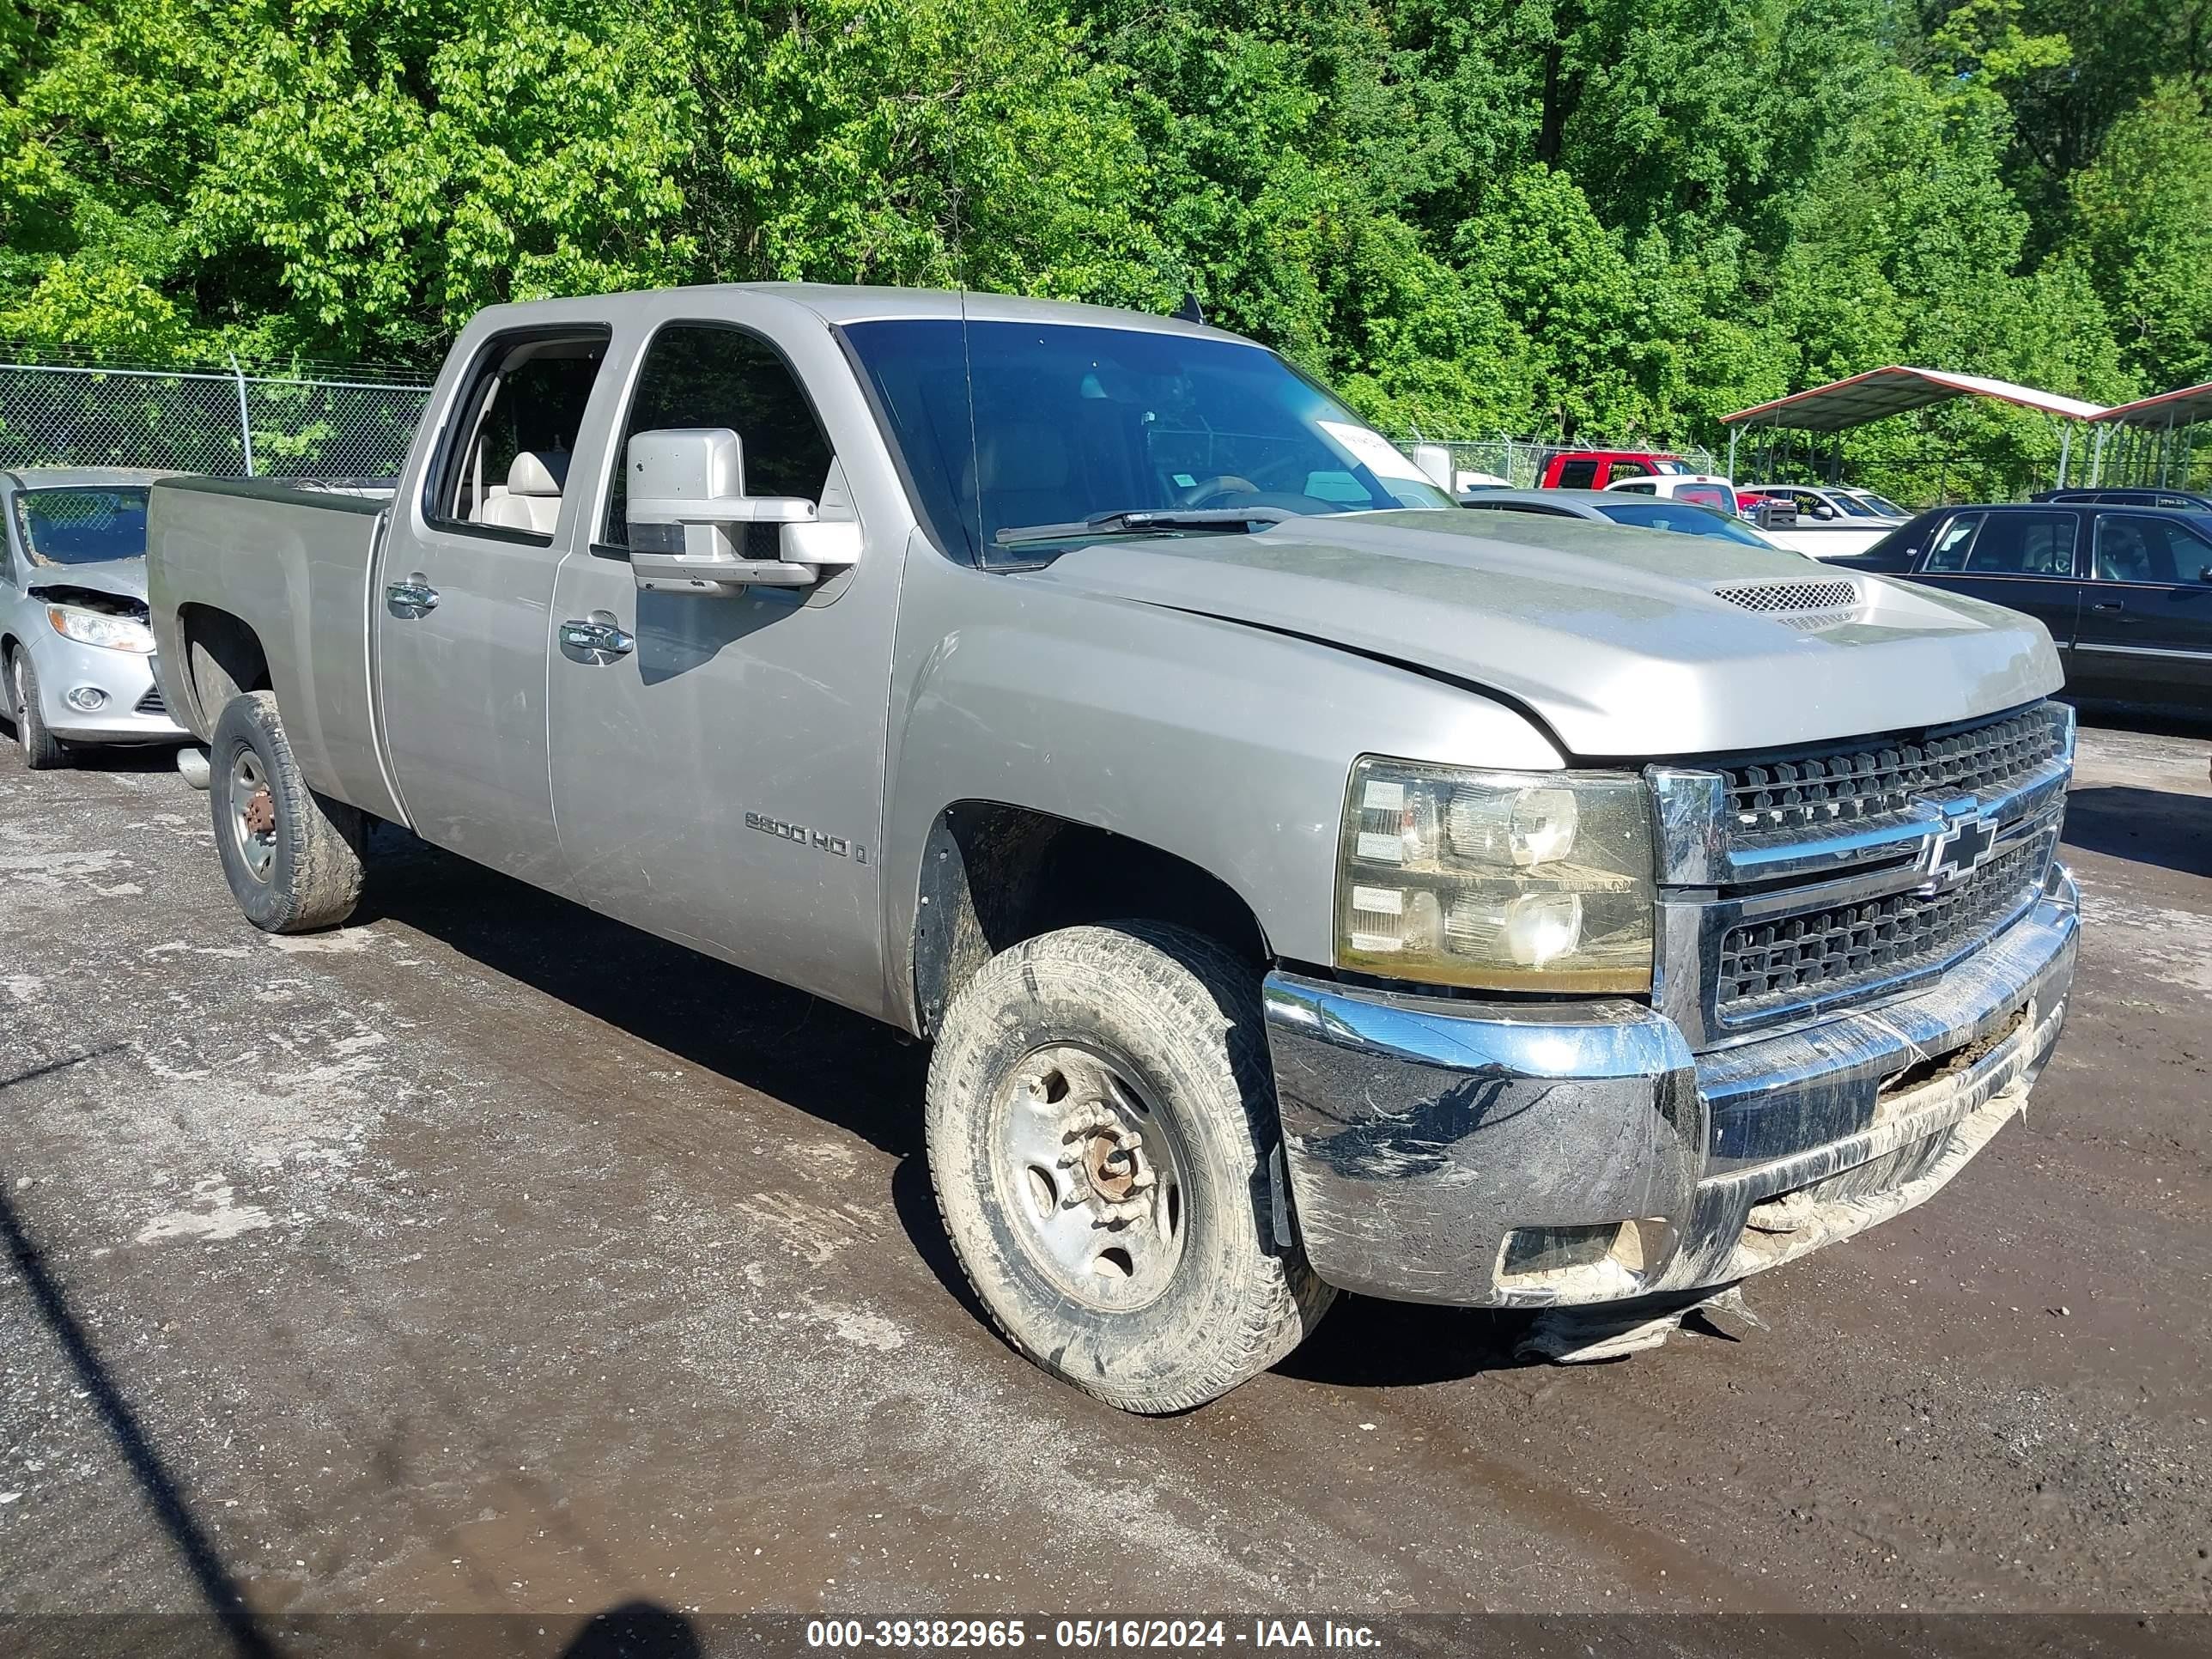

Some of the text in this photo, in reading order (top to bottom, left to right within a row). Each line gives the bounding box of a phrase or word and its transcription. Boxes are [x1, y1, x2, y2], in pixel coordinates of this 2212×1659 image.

[745, 811, 851, 856] 2500 HD
[1182, 1116, 1216, 1228] WILD
